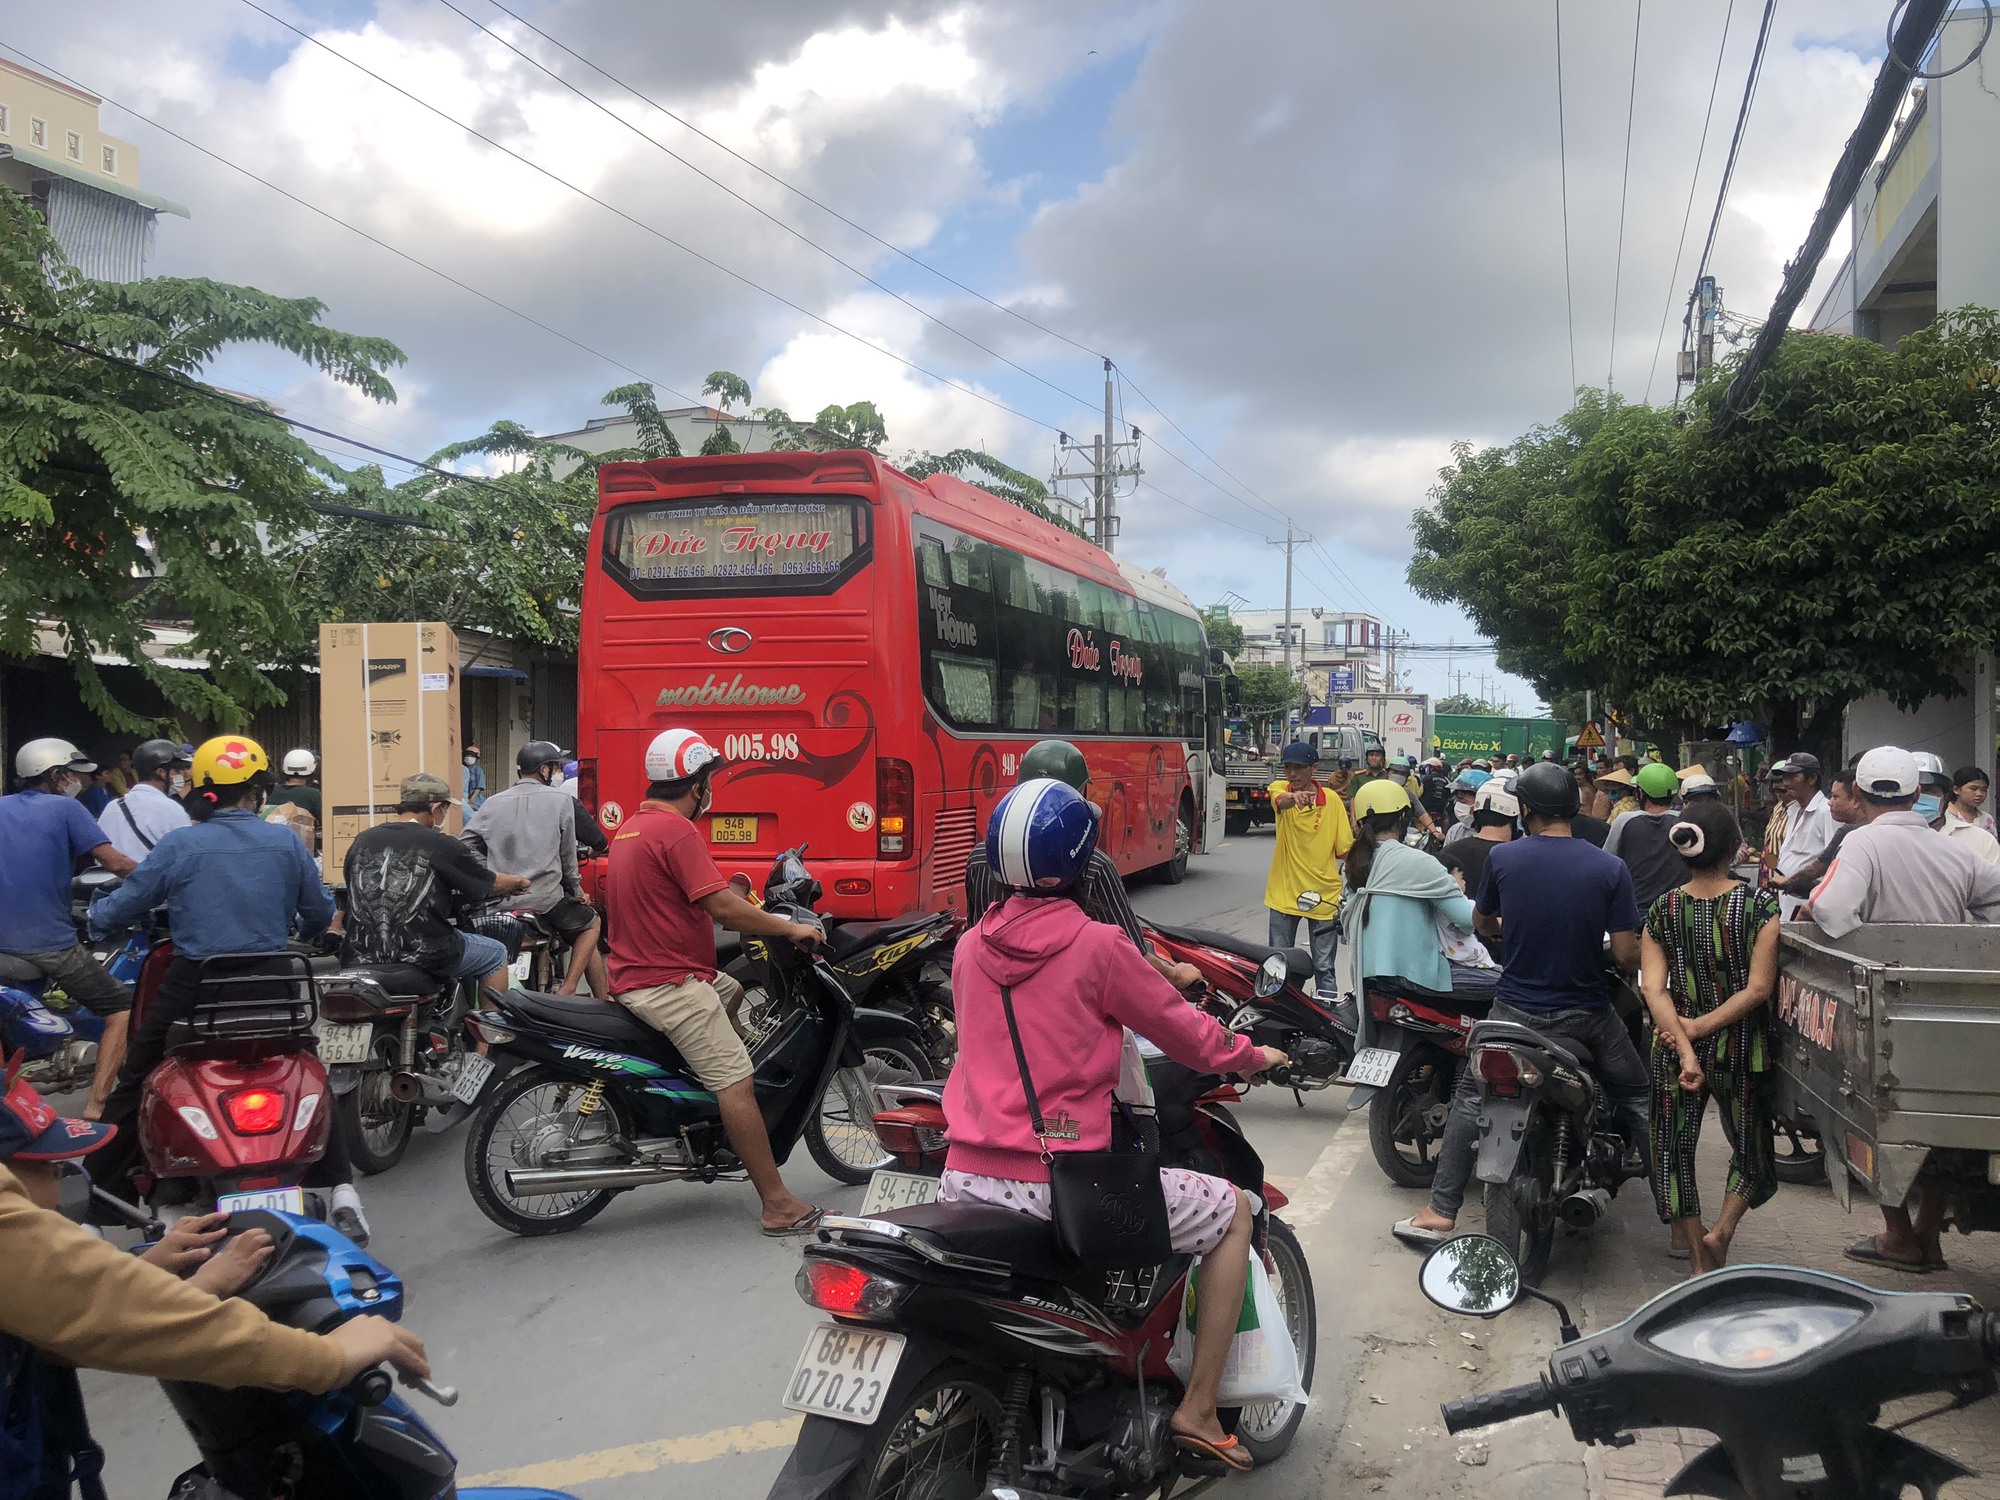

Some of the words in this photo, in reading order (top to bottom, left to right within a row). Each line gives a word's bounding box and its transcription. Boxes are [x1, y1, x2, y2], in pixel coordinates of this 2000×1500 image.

[667, 509, 692, 518] TNHH
[729, 506, 738, 514] &
[635, 529, 707, 558] Đức
[720, 527, 835, 557] Trọng
[648, 566, 705, 579] 02912.466.466
[712, 563, 773, 578] 02822.466.466
[928, 587, 952, 612] New
[936, 608, 978, 648] Home
[656, 674, 806, 706] mobihome
[1346, 712, 1364, 720] 94C
[1442, 738, 1468, 750] Bách
[1469, 741, 1488, 750] hóa
[724, 818, 744, 829] 94B
[716, 830, 752, 841] 005.98
[325, 1026, 362, 1042] 94-K1
[319, 1044, 364, 1062] 156.41
[563, 1044, 628, 1062] Wave
[1361, 1050, 1391, 1067] 69-L1
[593, 1062, 622, 1070] 110
[1350, 1066, 1388, 1084] 034.81
[456, 1076, 479, 1100] 8675
[878, 1177, 928, 1204] 94-F8
[817, 1328, 888, 1372] 68-K1
[792, 1368, 882, 1416] 070.23
